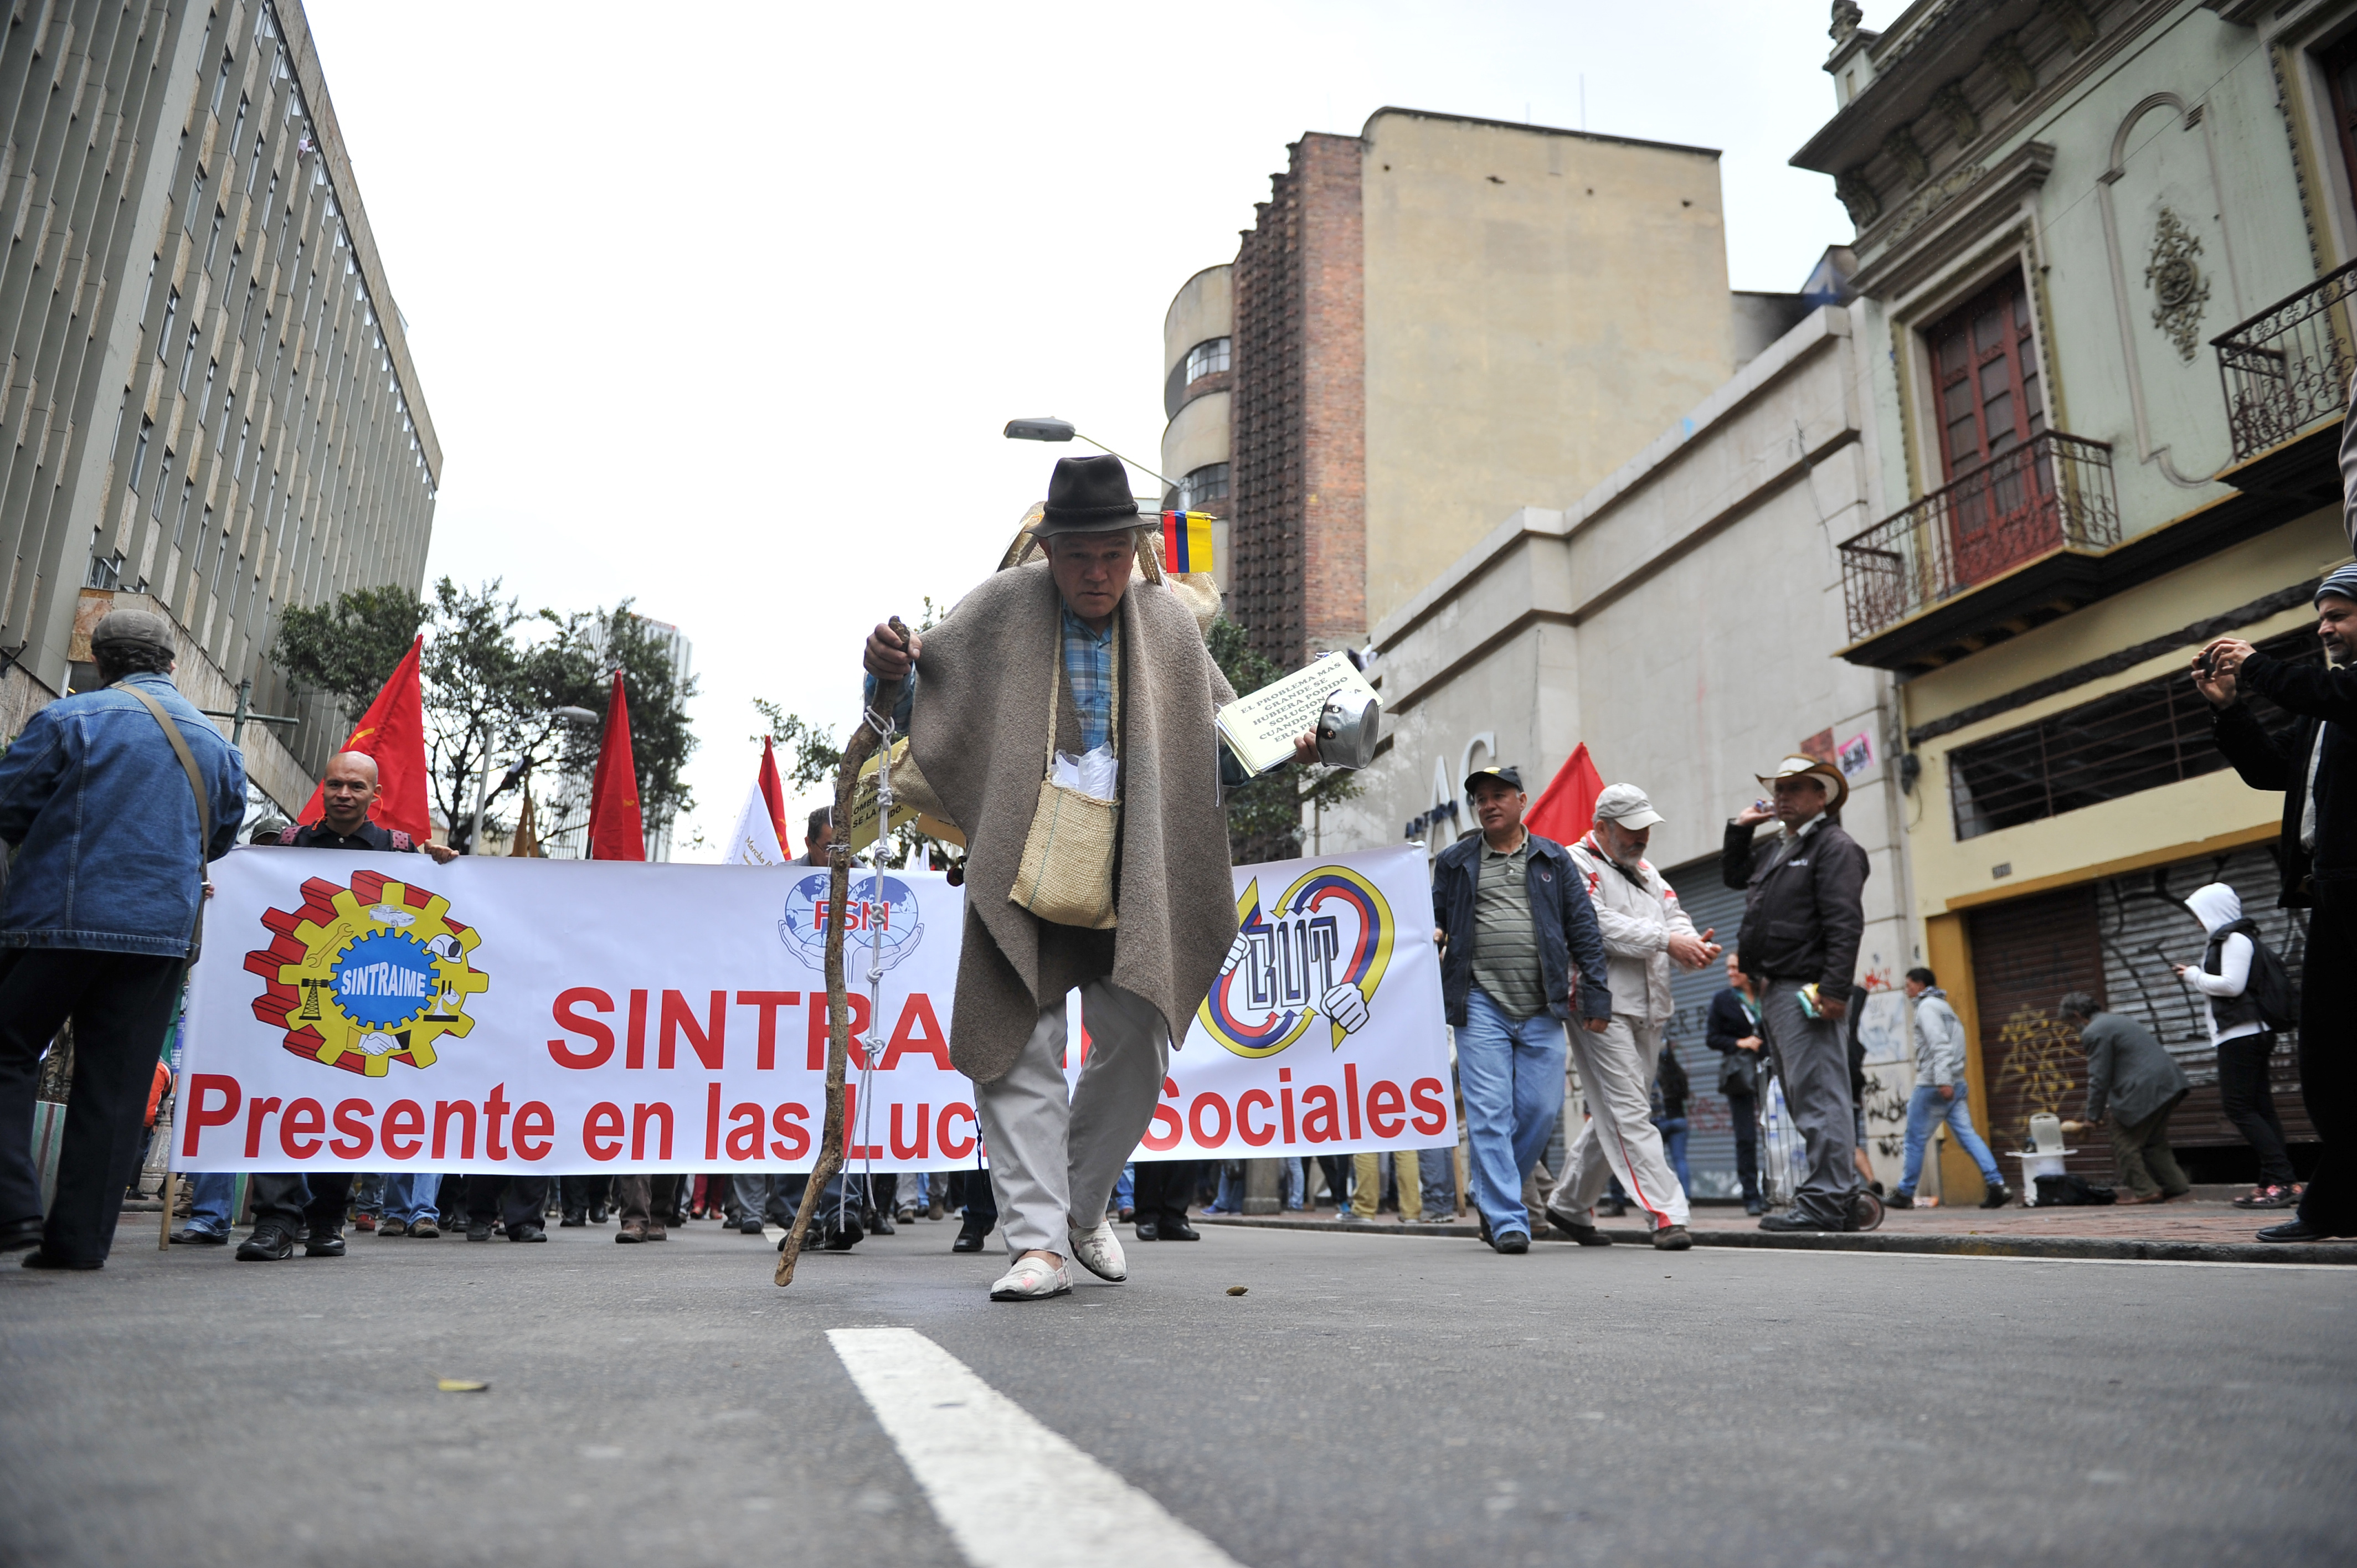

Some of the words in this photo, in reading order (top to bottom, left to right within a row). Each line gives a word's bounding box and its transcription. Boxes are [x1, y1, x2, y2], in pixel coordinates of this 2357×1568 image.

[1241, 705, 1254, 714] EL
[1256, 675, 1316, 707] PROBLEMA
[1317, 662, 1341, 677] MAS
[1253, 699, 1305, 725] HUBIERA
[1306, 676, 1349, 700] PODIDO
[1264, 685, 1313, 711] GRANDE
[1313, 677, 1328, 688] SE
[1259, 714, 1308, 740] CUANDO
[1273, 729, 1299, 743] ERA
[852, 817, 863, 829] SE
[866, 808, 878, 820] LA
[745, 835, 765, 864] Marcha
[814, 900, 889, 931] FSM
[341, 961, 426, 997] SINTRAIME
[1246, 915, 1339, 1011] CUT
[547, 987, 1092, 1070] SINTRA
[182, 1073, 555, 1161] Presente
[583, 1101, 675, 1161] en
[704, 1082, 811, 1161] las
[843, 1084, 987, 1160] Luc
[1141, 1062, 1448, 1152] Sociales
